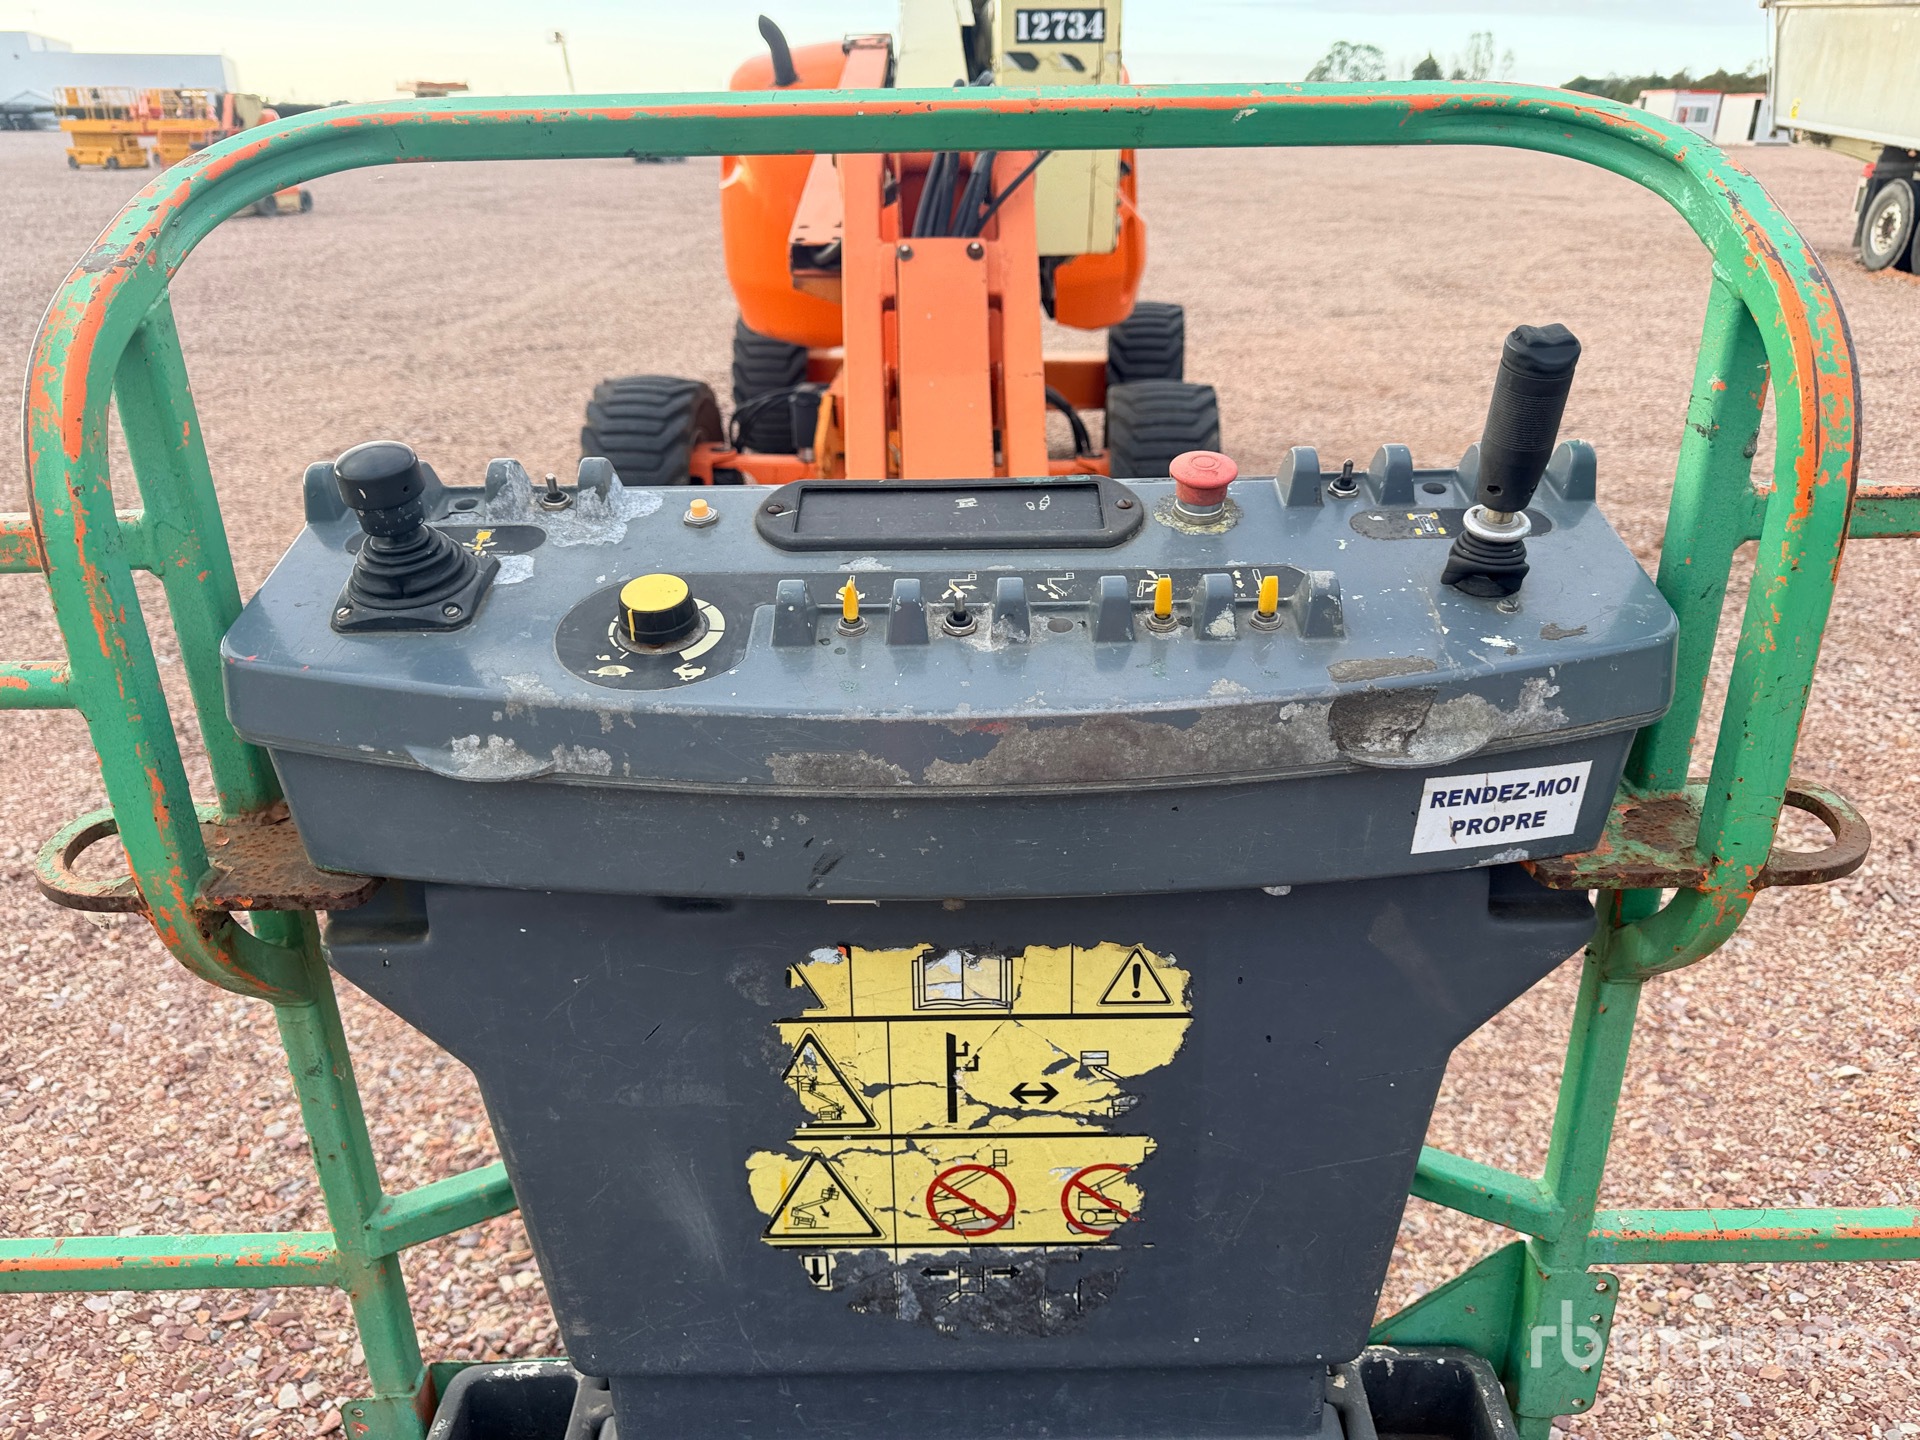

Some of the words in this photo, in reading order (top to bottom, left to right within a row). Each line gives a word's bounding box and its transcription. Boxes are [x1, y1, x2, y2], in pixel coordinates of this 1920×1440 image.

[1017, 11, 1105, 41] 12734
[1430, 776, 1580, 809] RENDEZ-MOI
[1451, 810, 1548, 837] PROPRE
